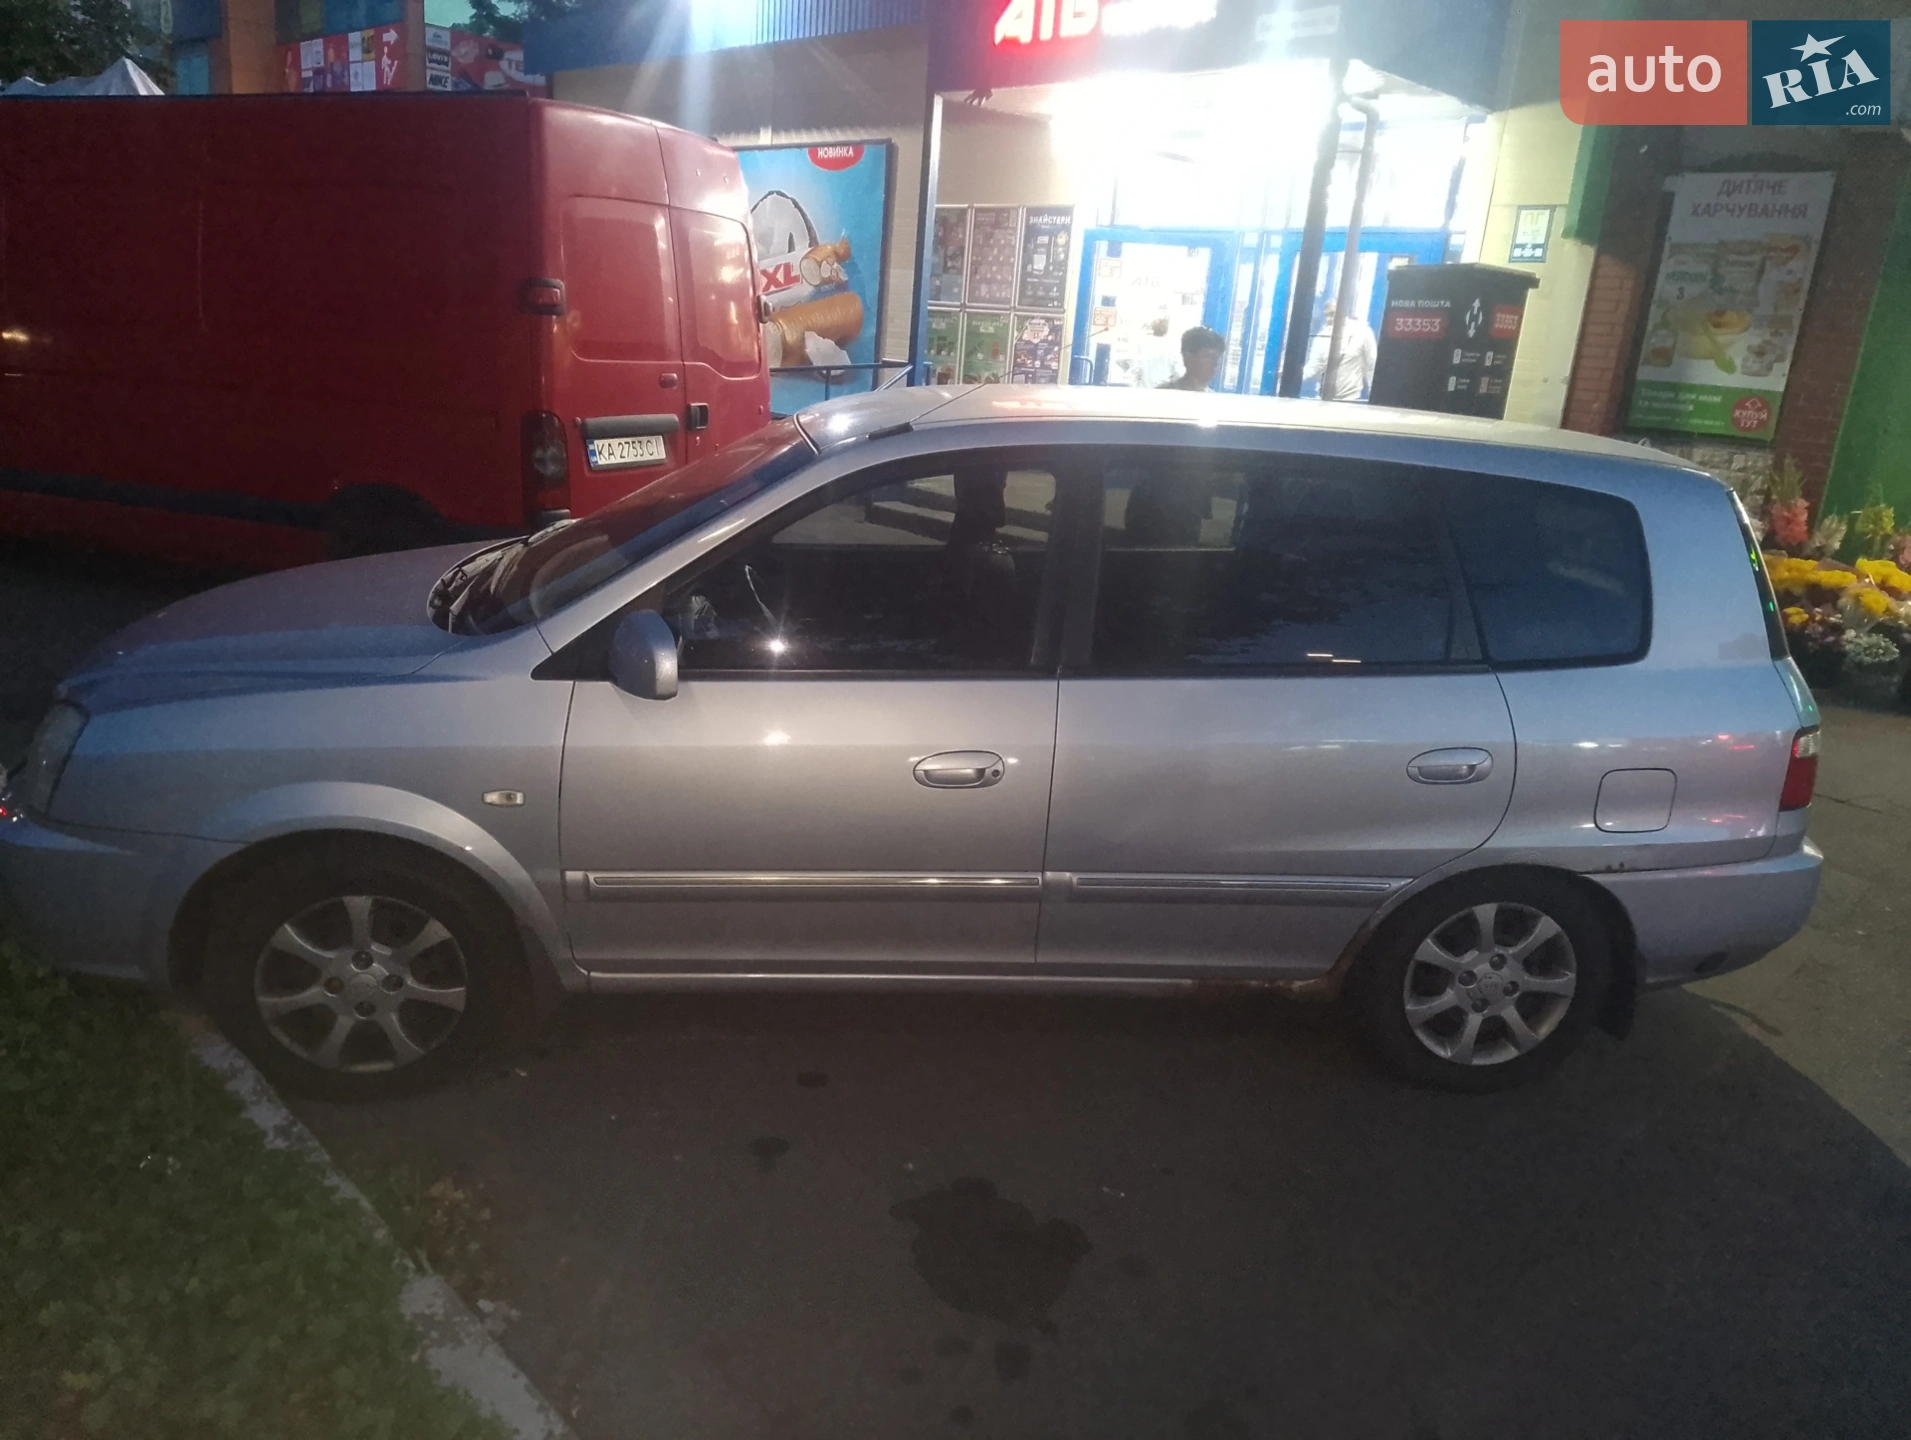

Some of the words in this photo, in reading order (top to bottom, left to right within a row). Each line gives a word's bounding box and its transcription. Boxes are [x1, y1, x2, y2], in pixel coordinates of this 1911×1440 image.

[428, 73, 450, 88] NIKE
[817, 146, 854, 159] НОВИНКА
[1717, 178, 1789, 197] ДИТЯЧЕ
[1690, 202, 1809, 219] ХАРЧУВАННЯ
[760, 262, 801, 292] XL
[1391, 300, 1416, 308] НОВА
[1418, 301, 1451, 309] ПОШТА
[1394, 318, 1441, 332] 33353
[1733, 409, 1768, 421] КУПУЙ
[1740, 419, 1758, 429] ТУТ
[618, 440, 645, 458] 2753
